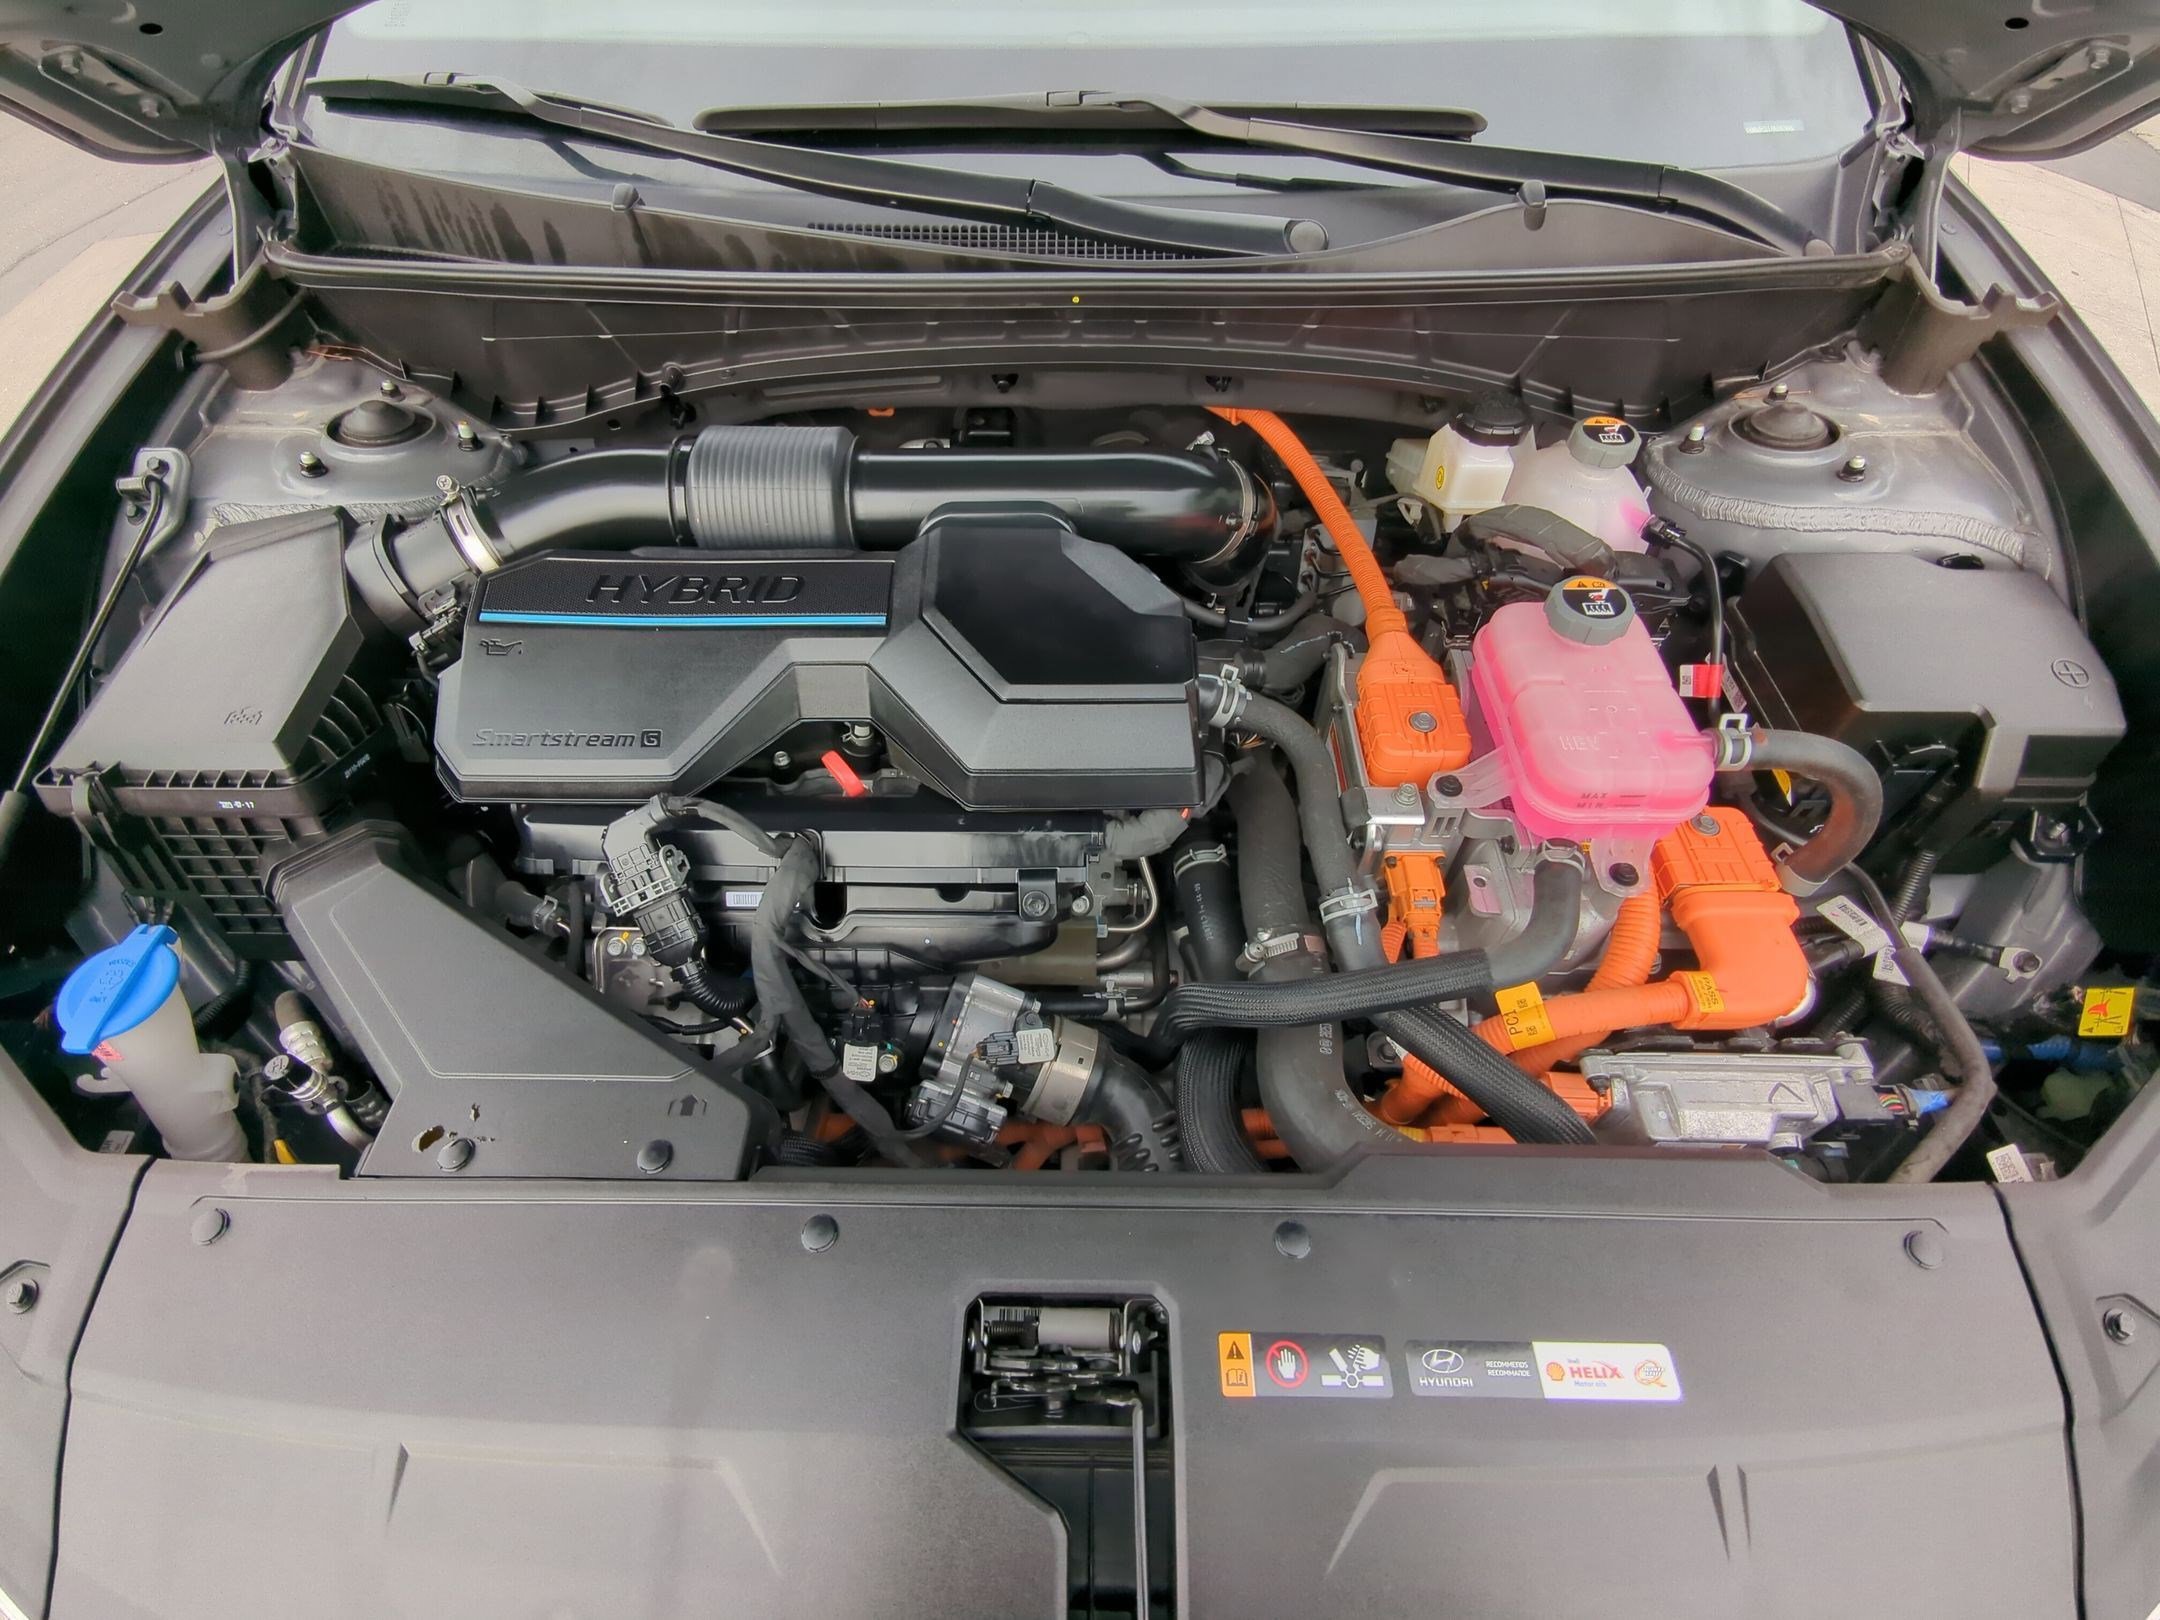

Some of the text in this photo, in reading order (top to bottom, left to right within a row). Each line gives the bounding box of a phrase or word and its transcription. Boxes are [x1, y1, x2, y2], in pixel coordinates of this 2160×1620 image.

[585, 575, 806, 604] HYBRID
[473, 729, 635, 748] Smartstream
[1581, 792, 1608, 800] MAX
[1502, 1008, 1524, 1037] PC1
[1569, 1365, 1623, 1379] HELIX
[1419, 1376, 1474, 1388] HYUNDAI
